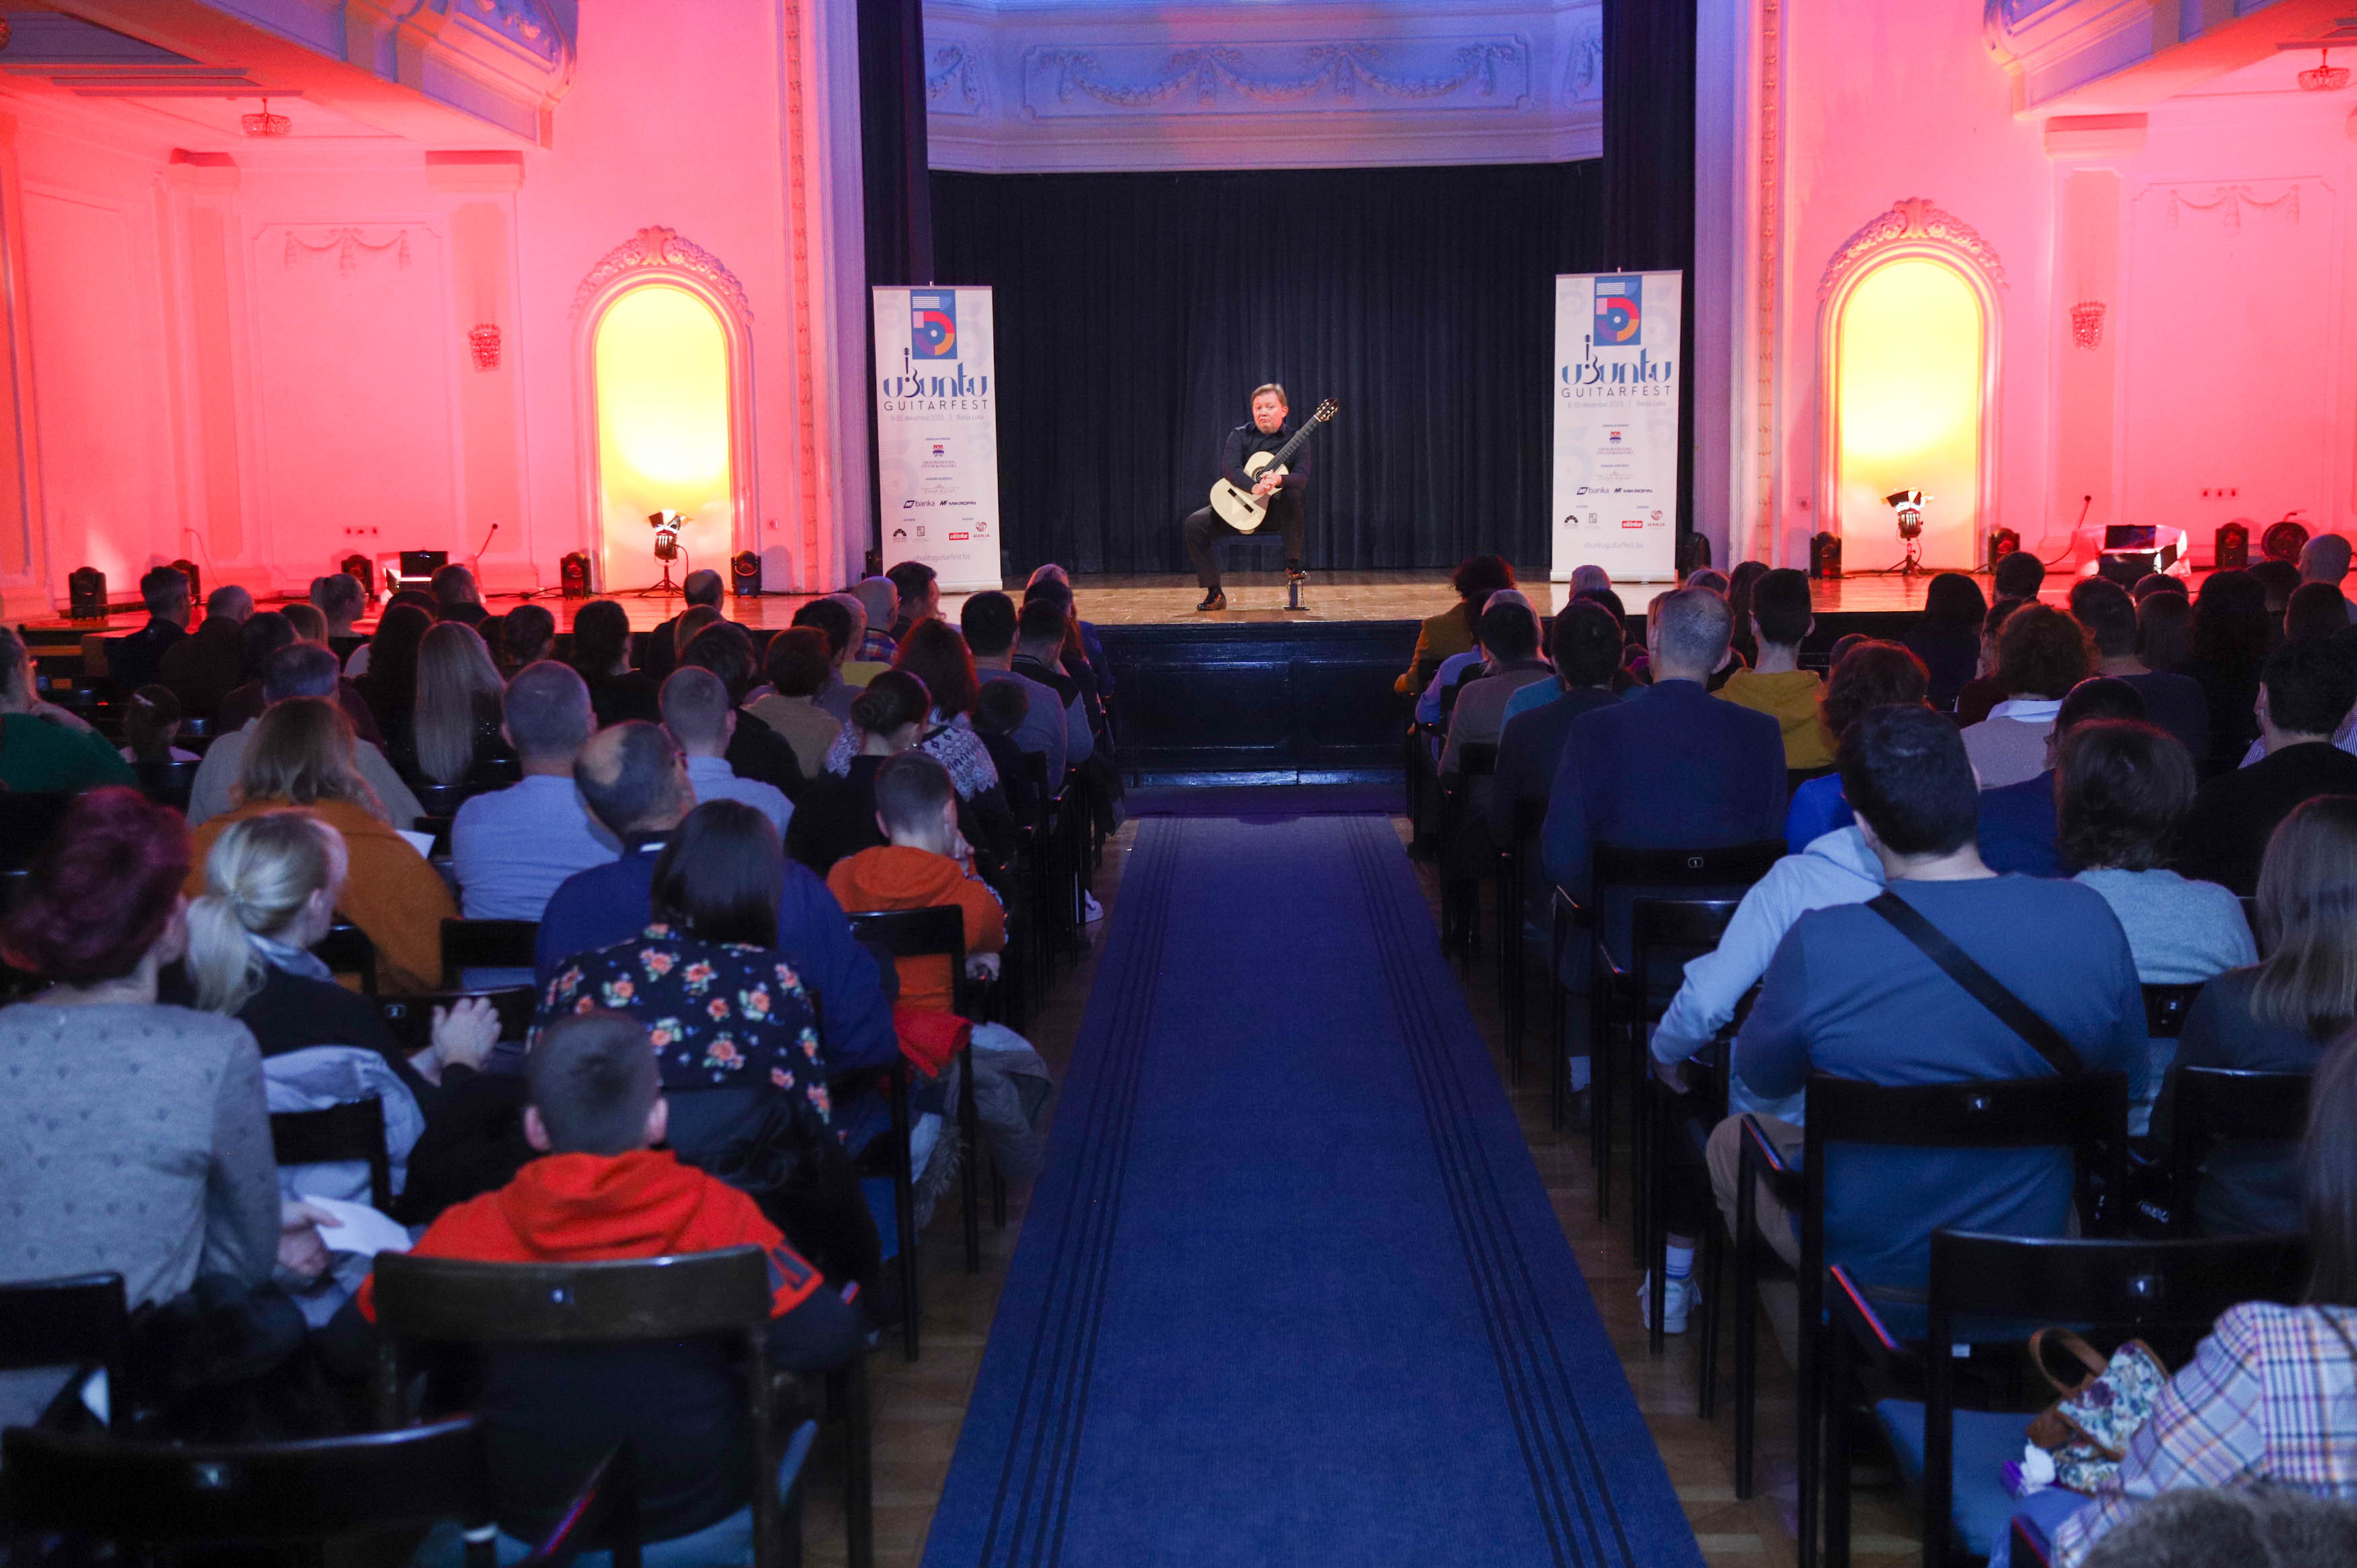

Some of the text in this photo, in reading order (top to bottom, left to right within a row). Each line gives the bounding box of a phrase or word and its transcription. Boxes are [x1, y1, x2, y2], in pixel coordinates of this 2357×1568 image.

[1561, 385, 1671, 398] GUITARFEST
[884, 400, 988, 411] GUITARFEST
[2170, 1002, 2177, 1010] 2
[1976, 1099, 1982, 1109] 1
